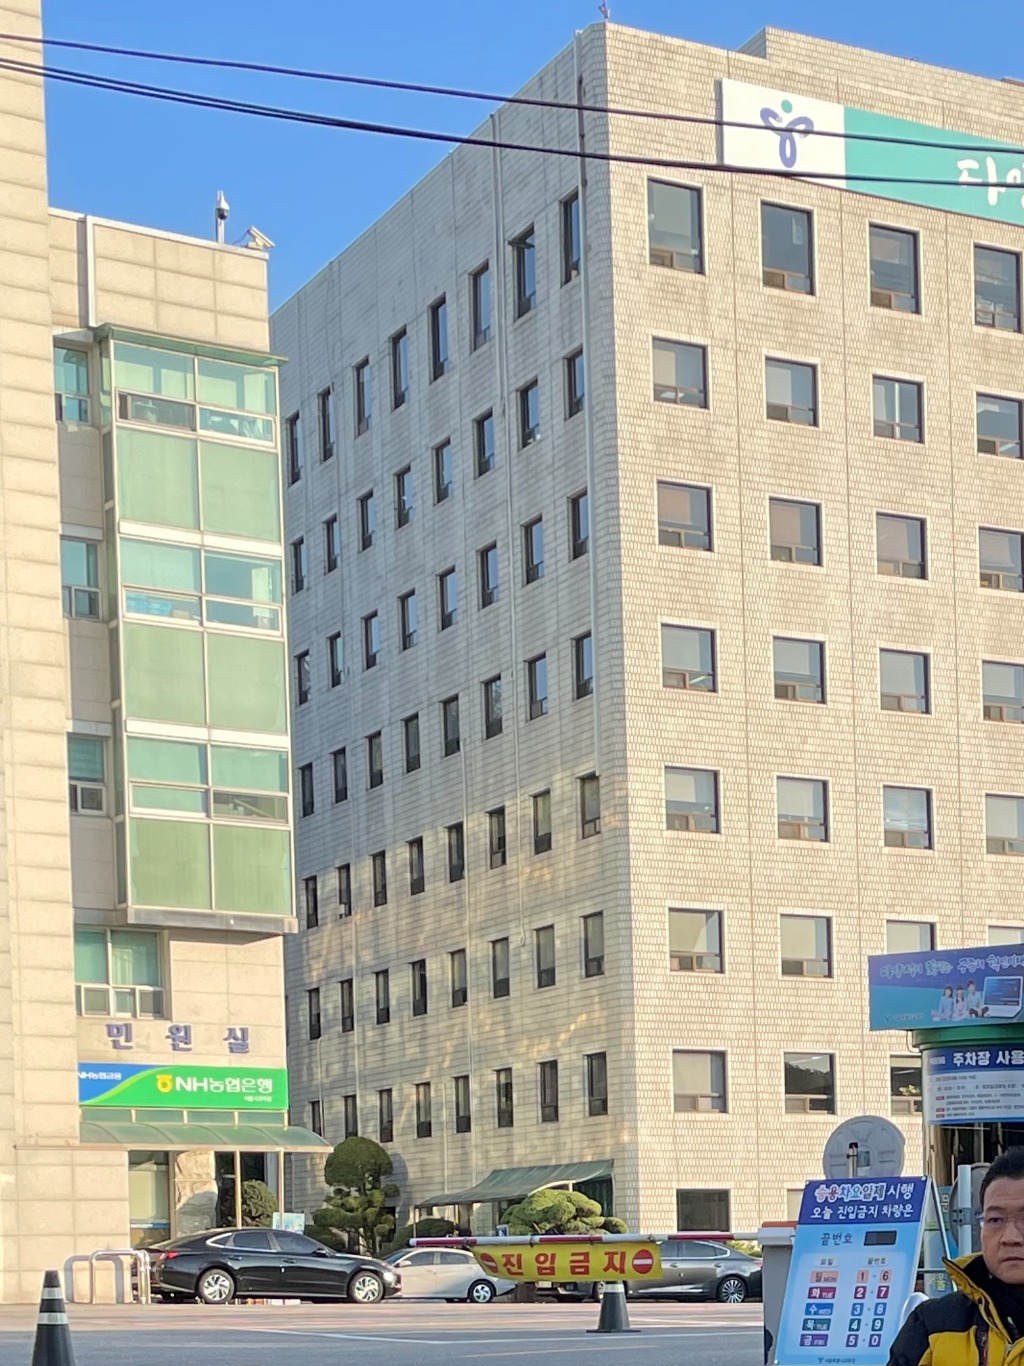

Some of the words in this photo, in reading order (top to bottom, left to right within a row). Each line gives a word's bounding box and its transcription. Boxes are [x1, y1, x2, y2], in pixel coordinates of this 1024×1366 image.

[105, 1022, 250, 1053] 민원실
[953, 1051, 991, 1067] 주차장
[175, 1076, 273, 1094] NH농협은행
[814, 1182, 886, 1203] 승용차요일제
[887, 1182, 914, 1200] 시행
[811, 1206, 833, 1220] 오늘
[837, 1205, 878, 1219] 진입금지
[882, 1203, 914, 1218] 차량은
[821, 1232, 853, 1246] 끝번호
[501, 1250, 627, 1276] 진입금지
[860, 1271, 865, 1281] 1
[882, 1270, 889, 1281] 6
[856, 1287, 864, 1298] 2
[880, 1287, 887, 1298] 7
[808, 1304, 818, 1315] 수
[854, 1304, 861, 1315] 3
[876, 1304, 884, 1314] 8
[850, 1319, 858, 1330] 4
[874, 1319, 882, 1330] 9
[848, 1335, 856, 1346] 5
[871, 1335, 879, 1346] 0
